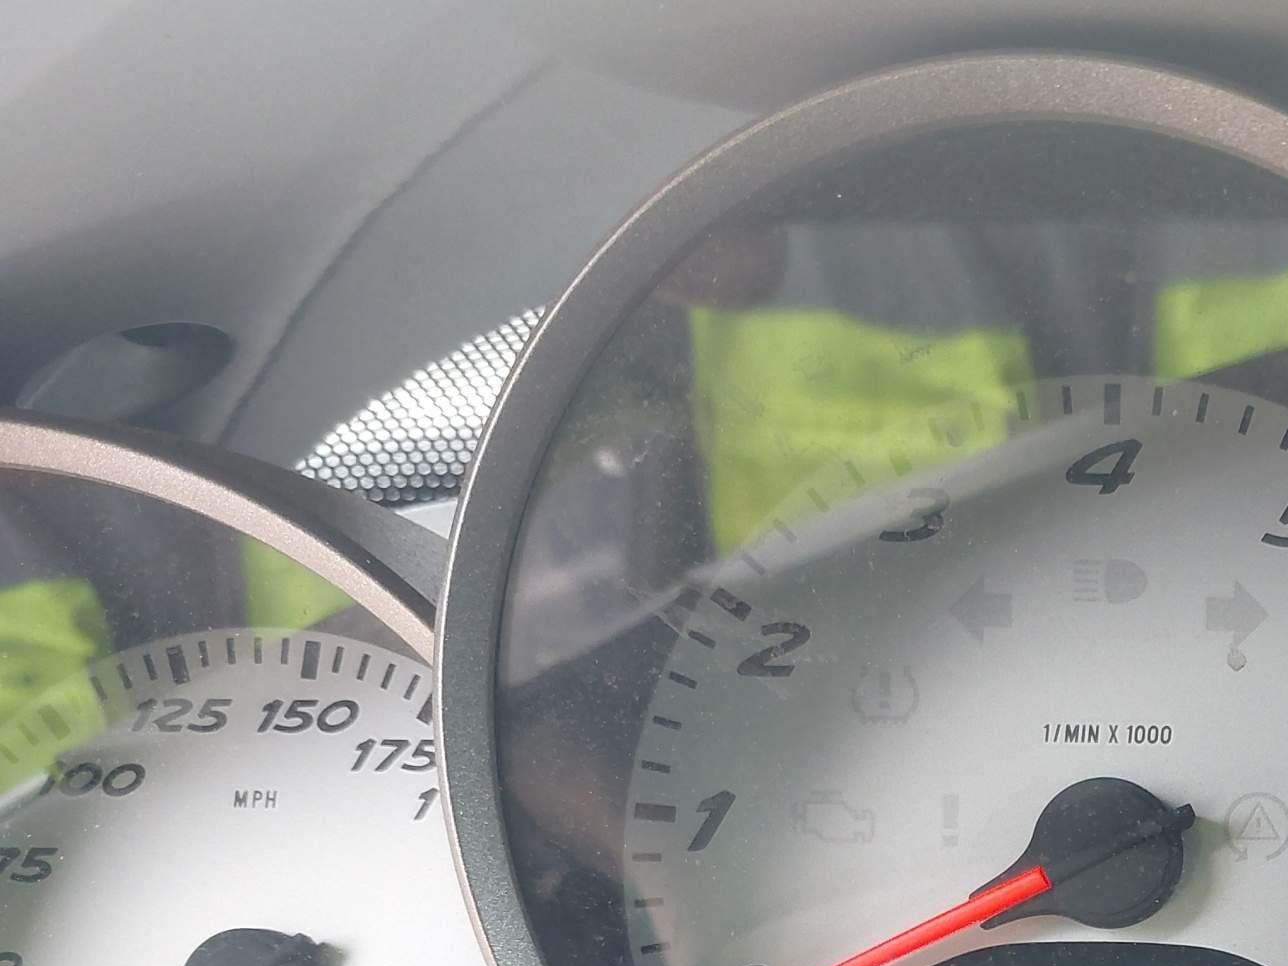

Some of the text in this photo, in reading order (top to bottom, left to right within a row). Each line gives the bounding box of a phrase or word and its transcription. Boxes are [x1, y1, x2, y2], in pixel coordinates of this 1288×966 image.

[1065, 439, 1142, 494] 4
[880, 488, 950, 542] 3
[737, 622, 811, 677] 2
[132, 698, 232, 733] 125
[257, 699, 360, 733] 150
[1042, 723, 1173, 746] 1/MIN X 1000
[351, 739, 436, 772] 175
[233, 790, 278, 808] MPH
[687, 790, 736, 851] 1
